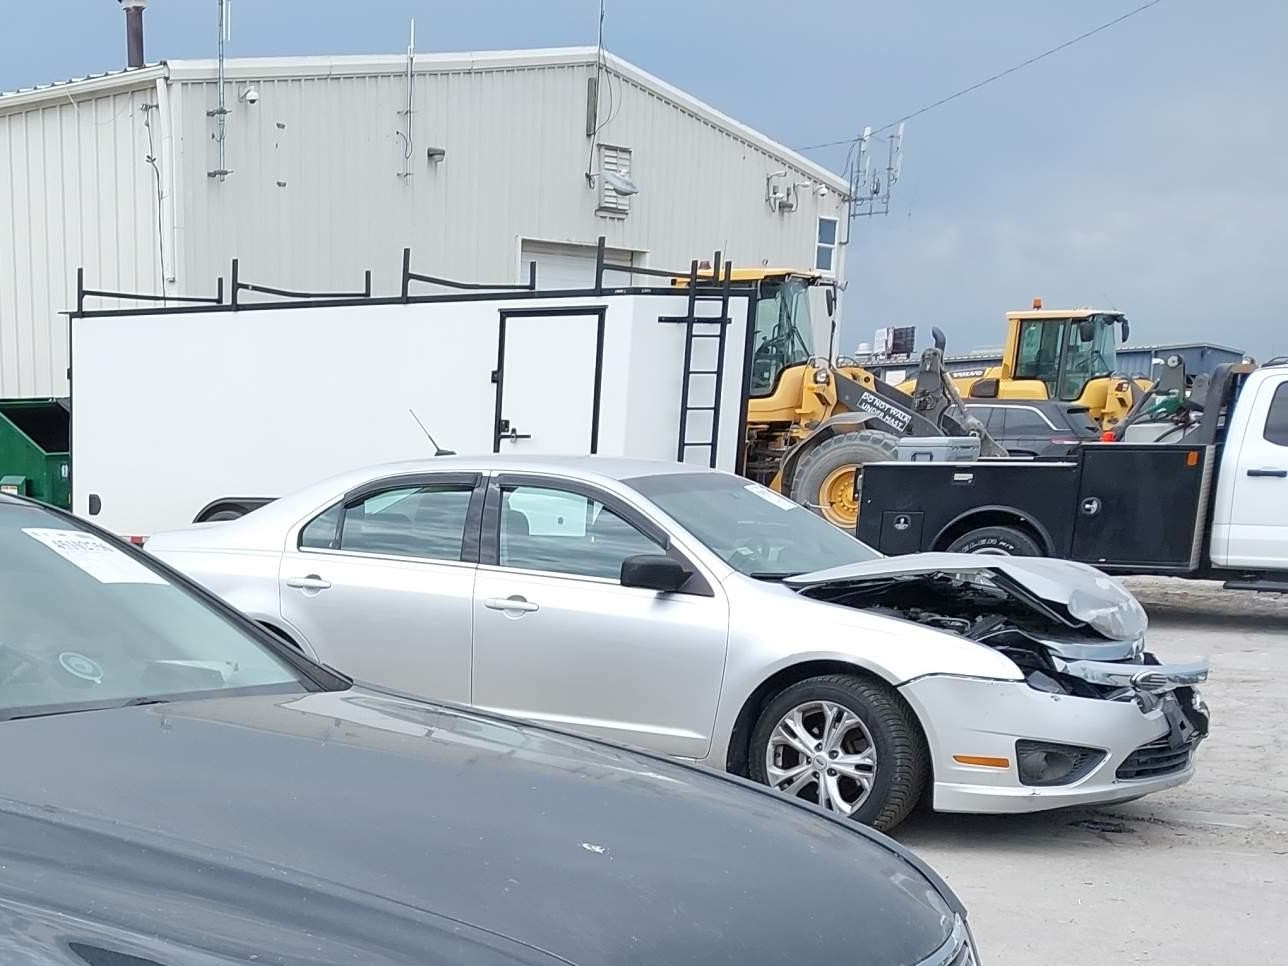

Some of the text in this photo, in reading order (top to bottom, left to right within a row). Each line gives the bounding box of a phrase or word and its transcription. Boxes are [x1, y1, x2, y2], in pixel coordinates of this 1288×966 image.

[862, 392, 911, 423] DO NOT WALK
[862, 402, 903, 428] UNDER MAST
